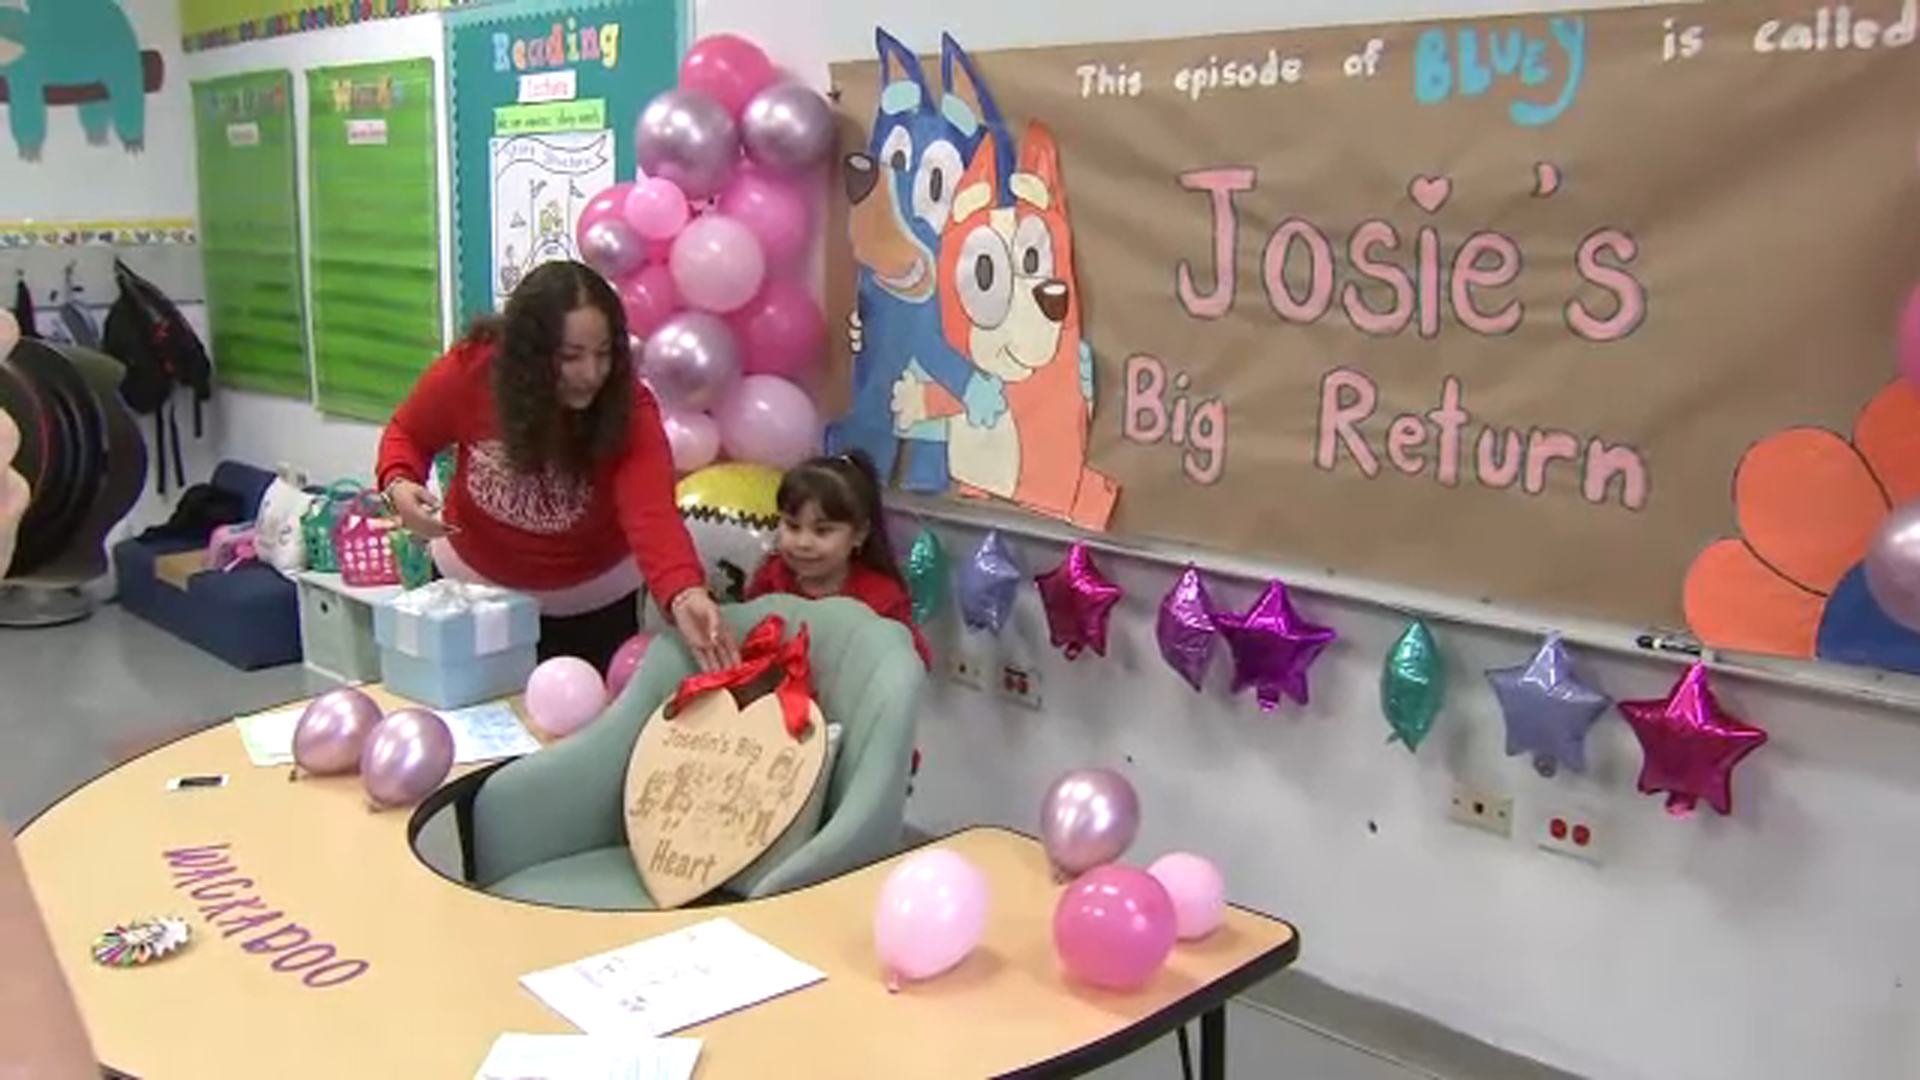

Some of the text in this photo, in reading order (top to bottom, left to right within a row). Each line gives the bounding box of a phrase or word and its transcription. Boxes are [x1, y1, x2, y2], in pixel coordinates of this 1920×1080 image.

[492, 17, 619, 71] Reading
[1076, 64, 1142, 97] This
[1174, 49, 1302, 100] episode
[1343, 38, 1383, 76] of
[1662, 18, 1703, 61] is
[1753, 2, 1918, 53] called
[1176, 161, 1647, 341] Josie's
[1122, 353, 1651, 510] Big Return
[734, 736, 763, 765] Big
[649, 839, 718, 884] Heart
